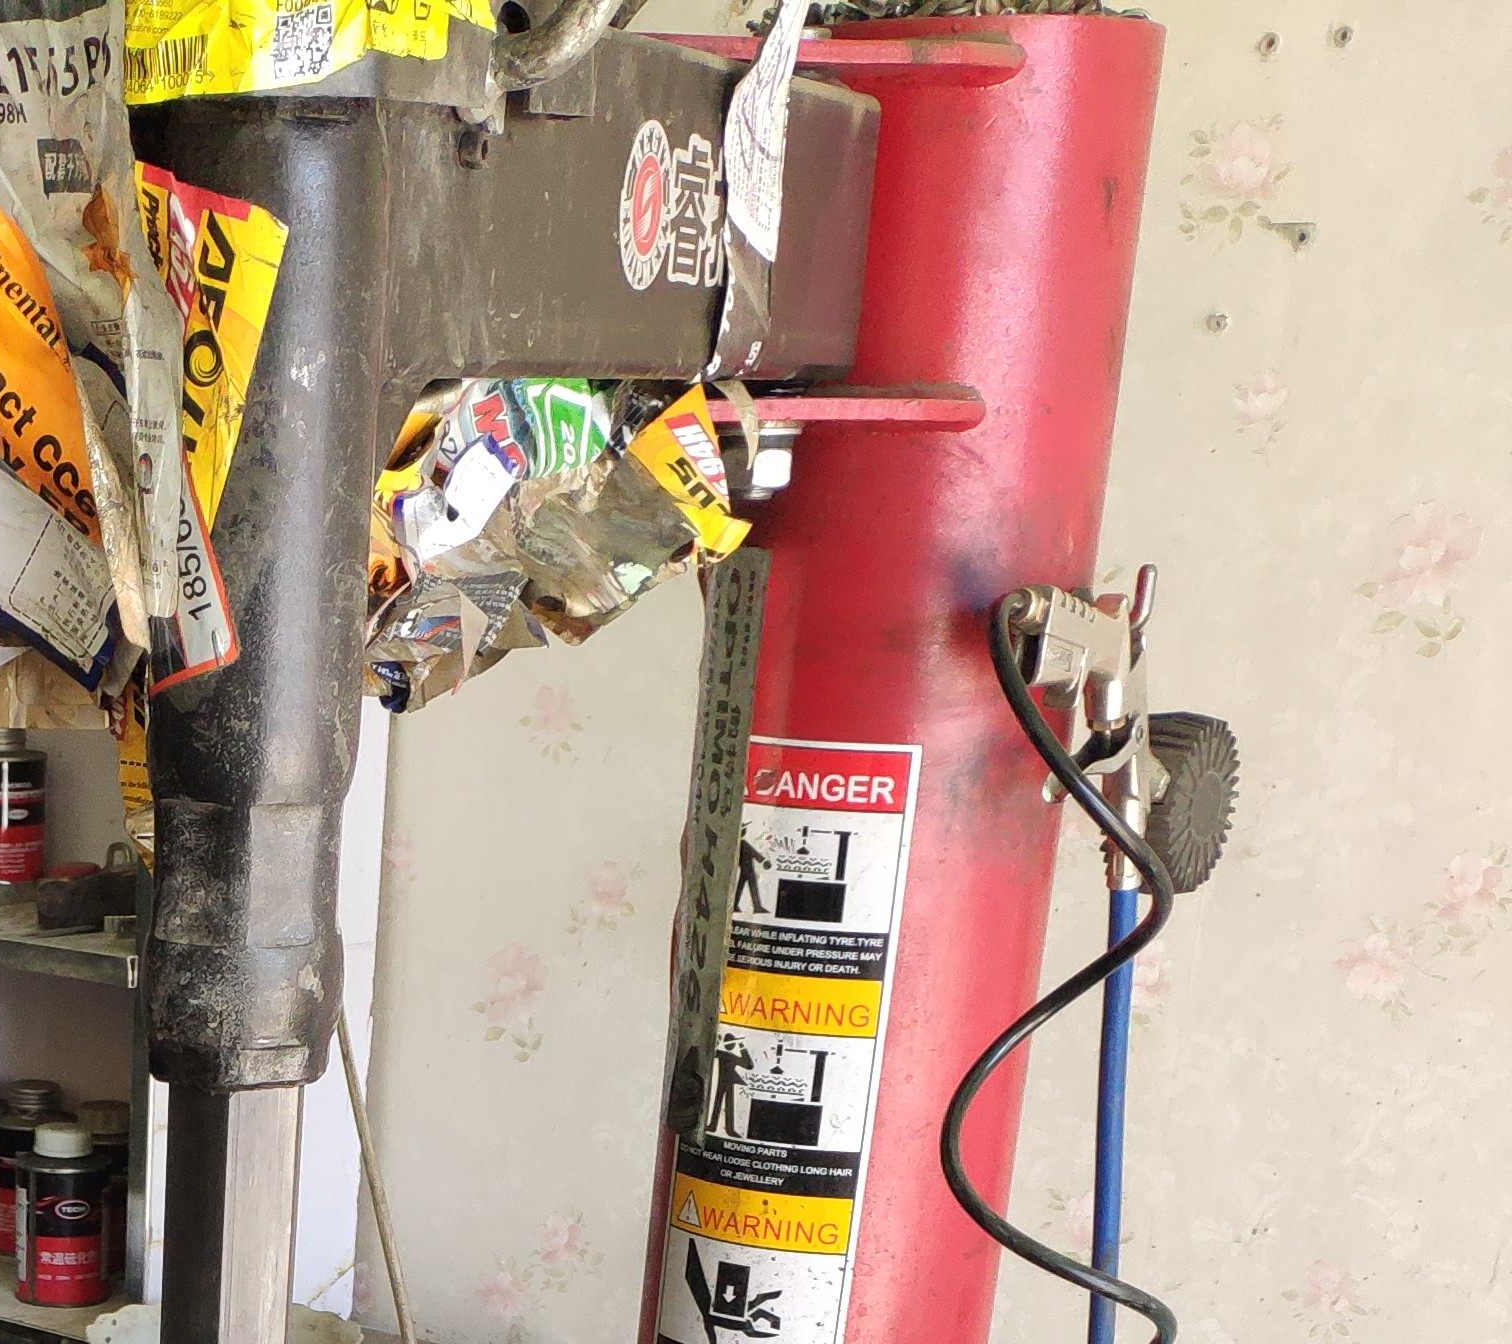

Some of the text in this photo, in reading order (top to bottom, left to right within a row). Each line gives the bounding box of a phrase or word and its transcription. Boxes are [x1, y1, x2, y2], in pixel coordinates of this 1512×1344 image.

[751, 929, 778, 941] WHILE
[778, 932, 828, 946] INFLATING
[738, 941, 771, 953] FAILURE
[772, 946, 805, 958] UNDER
[805, 949, 859, 961] PRESSURE
[860, 952, 884, 962] MAY
[738, 955, 773, 968] SERIOUS
[774, 960, 808, 972] INJURY
[808, 962, 824, 973] OR
[728, 991, 871, 1028] WARNING
[723, 1141, 789, 1158] MOVING PARTS
[702, 1150, 724, 1162] WEAR
[724, 1155, 752, 1168] LOOSE
[752, 1160, 799, 1174] CLOTHING
[800, 1166, 828, 1176] LONG
[829, 1168, 854, 1177] HAIR
[720, 1169, 786, 1187] OR JEWELLERY
[702, 1205, 840, 1245] WARNING
